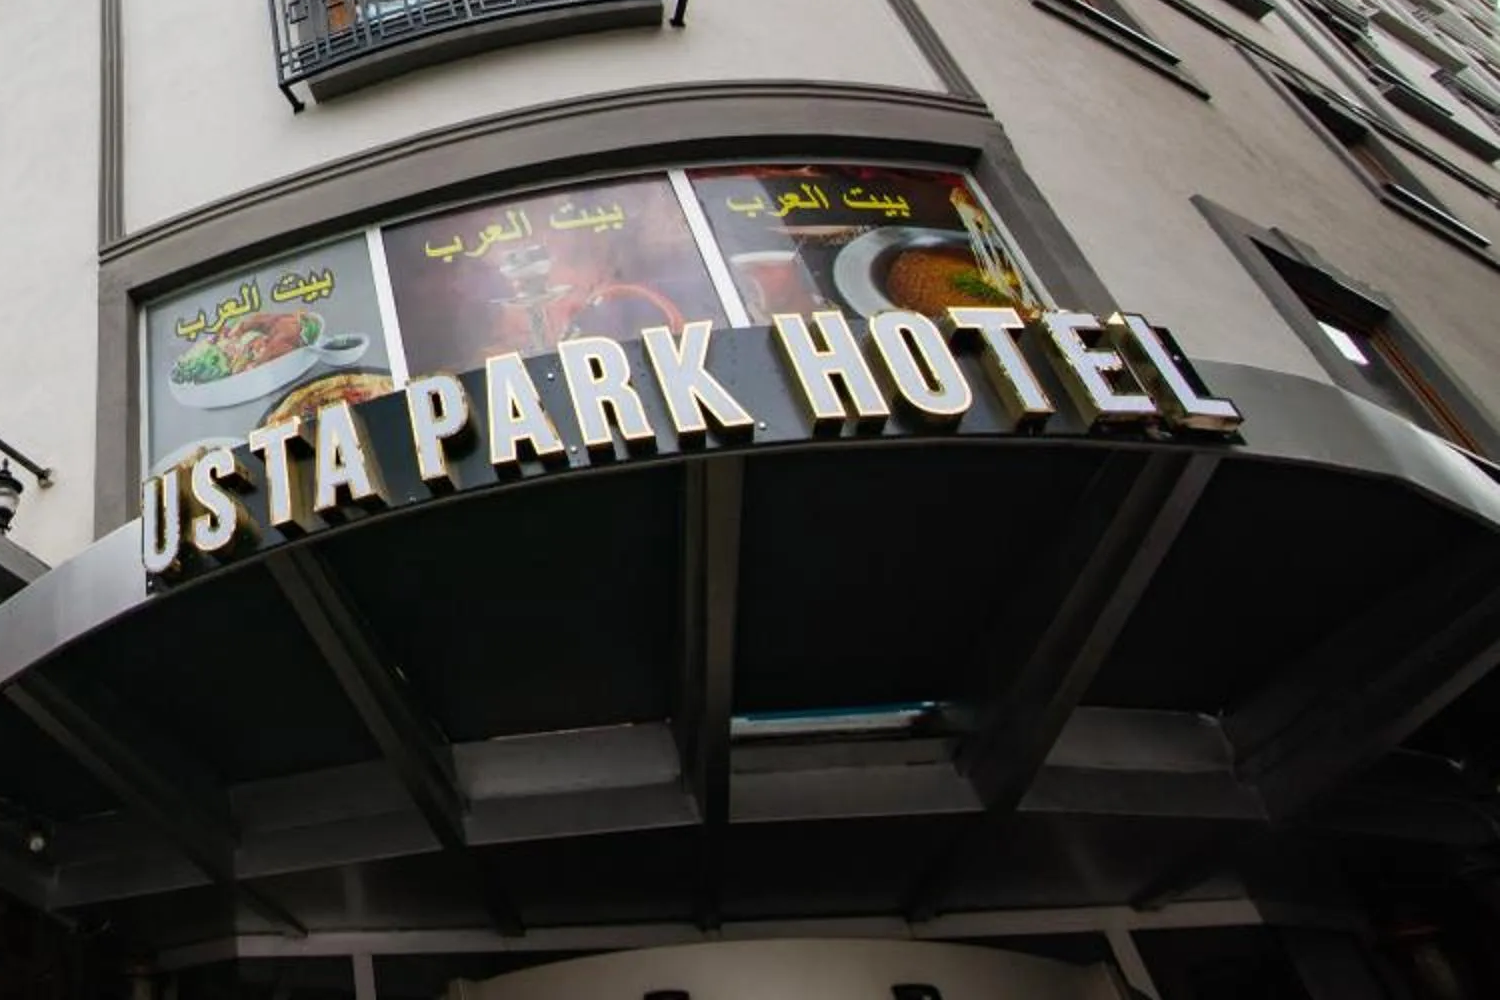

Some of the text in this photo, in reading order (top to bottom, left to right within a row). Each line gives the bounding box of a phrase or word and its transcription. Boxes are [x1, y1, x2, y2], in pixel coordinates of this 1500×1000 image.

[424, 202, 626, 263] بيت العرب
[725, 182, 912, 218] بيت العرب
[175, 267, 334, 342] بيت العرب
[141, 306, 1245, 574] USTA PARK HOTEL
